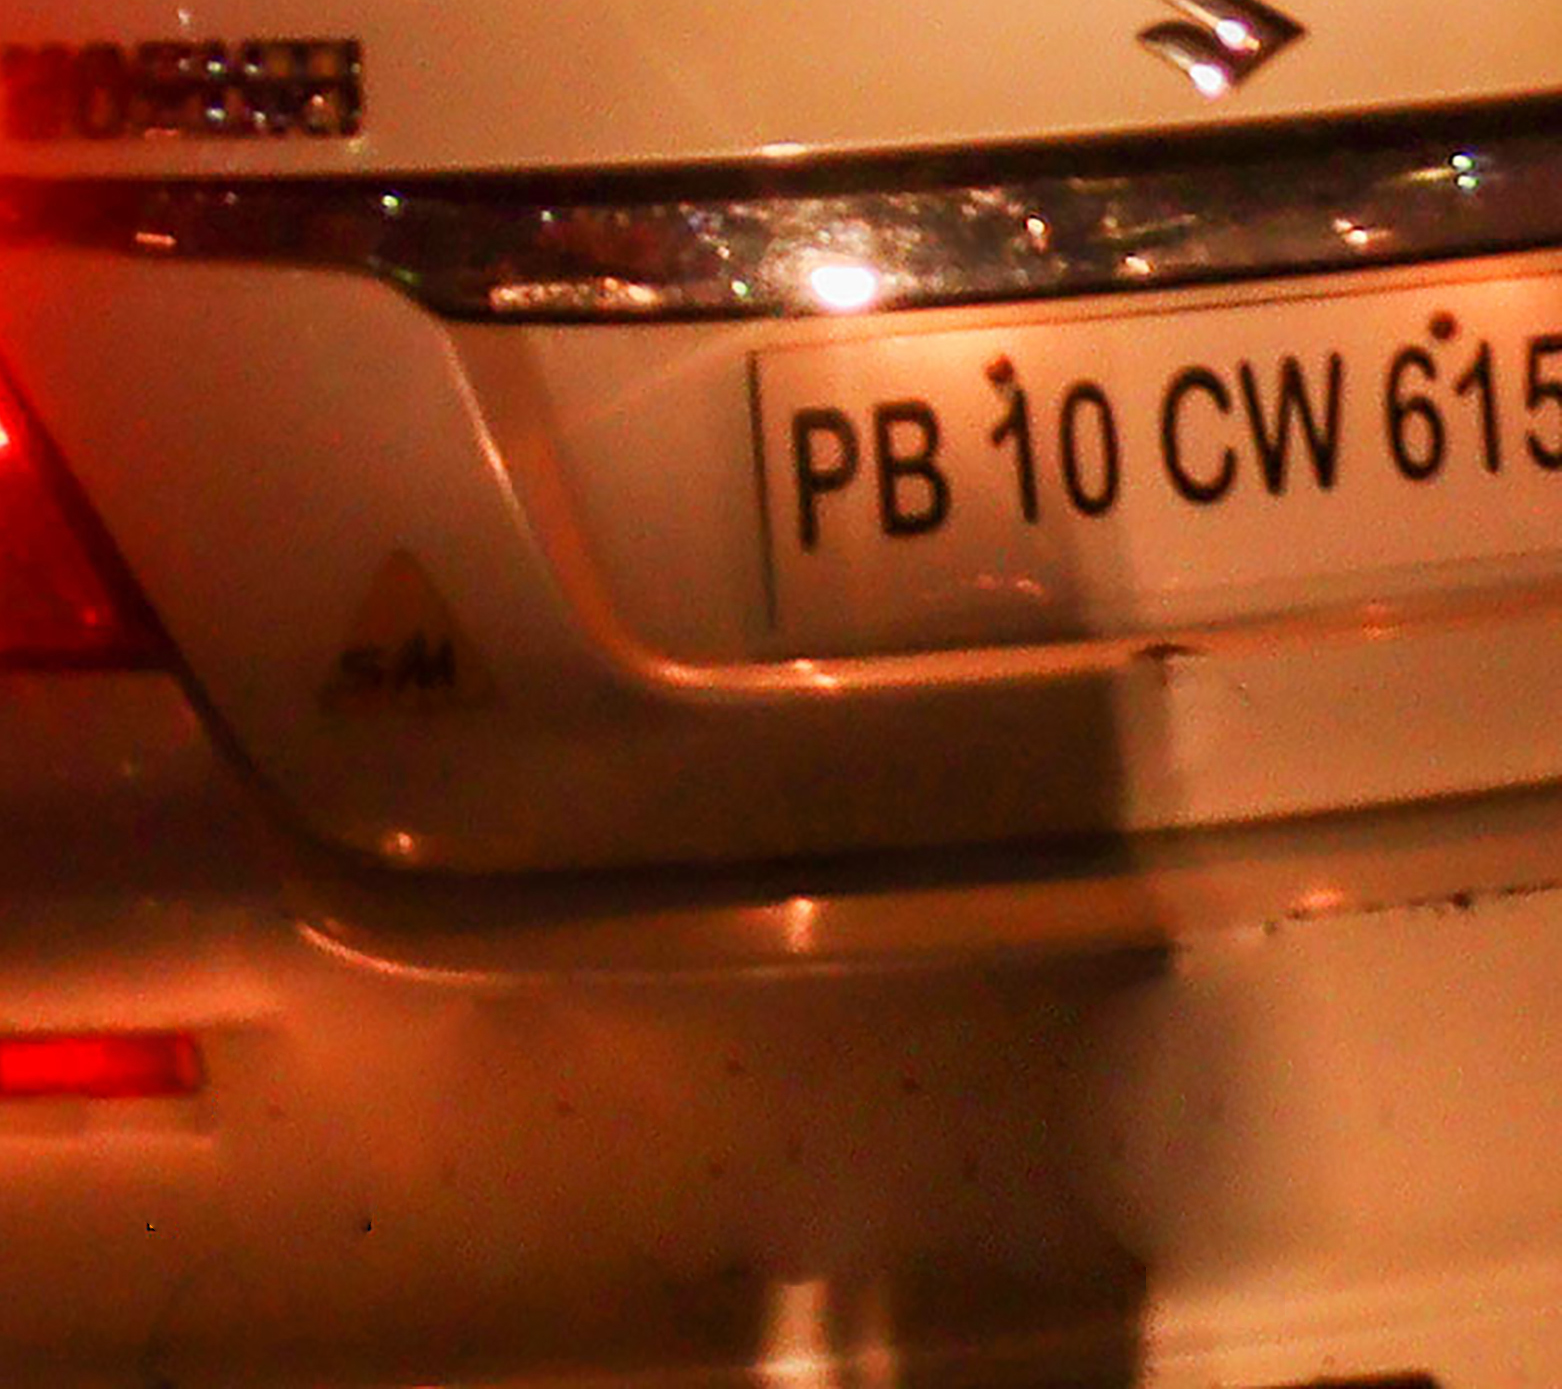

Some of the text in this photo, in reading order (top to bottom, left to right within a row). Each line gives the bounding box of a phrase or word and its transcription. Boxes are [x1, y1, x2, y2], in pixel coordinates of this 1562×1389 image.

[792, 399, 950, 550] PB
[990, 381, 1119, 522] 10
[1161, 353, 1344, 504] CW
